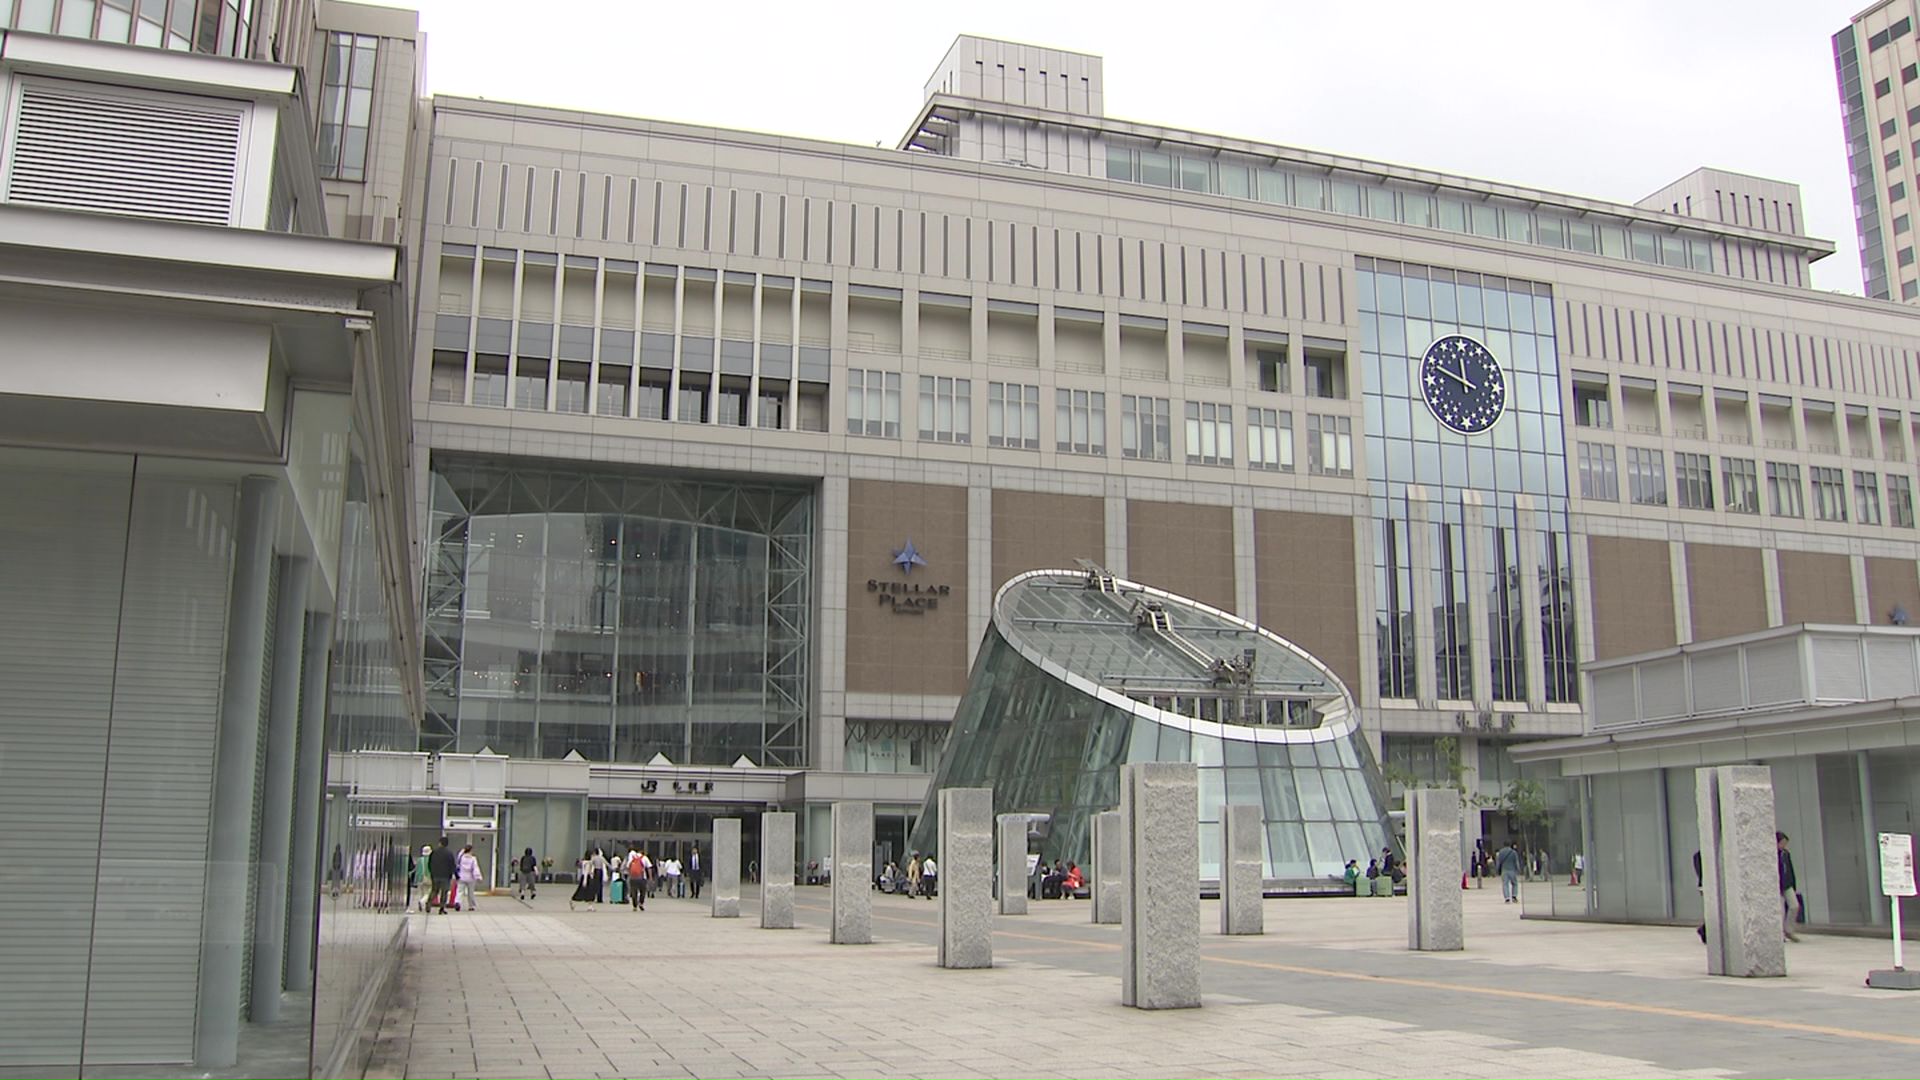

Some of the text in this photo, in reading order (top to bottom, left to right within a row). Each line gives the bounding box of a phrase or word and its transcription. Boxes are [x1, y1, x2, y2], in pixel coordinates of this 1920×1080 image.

[866, 579, 950, 597] STELLAR
[879, 594, 938, 610] PLACE
[641, 780, 658, 793] JR
